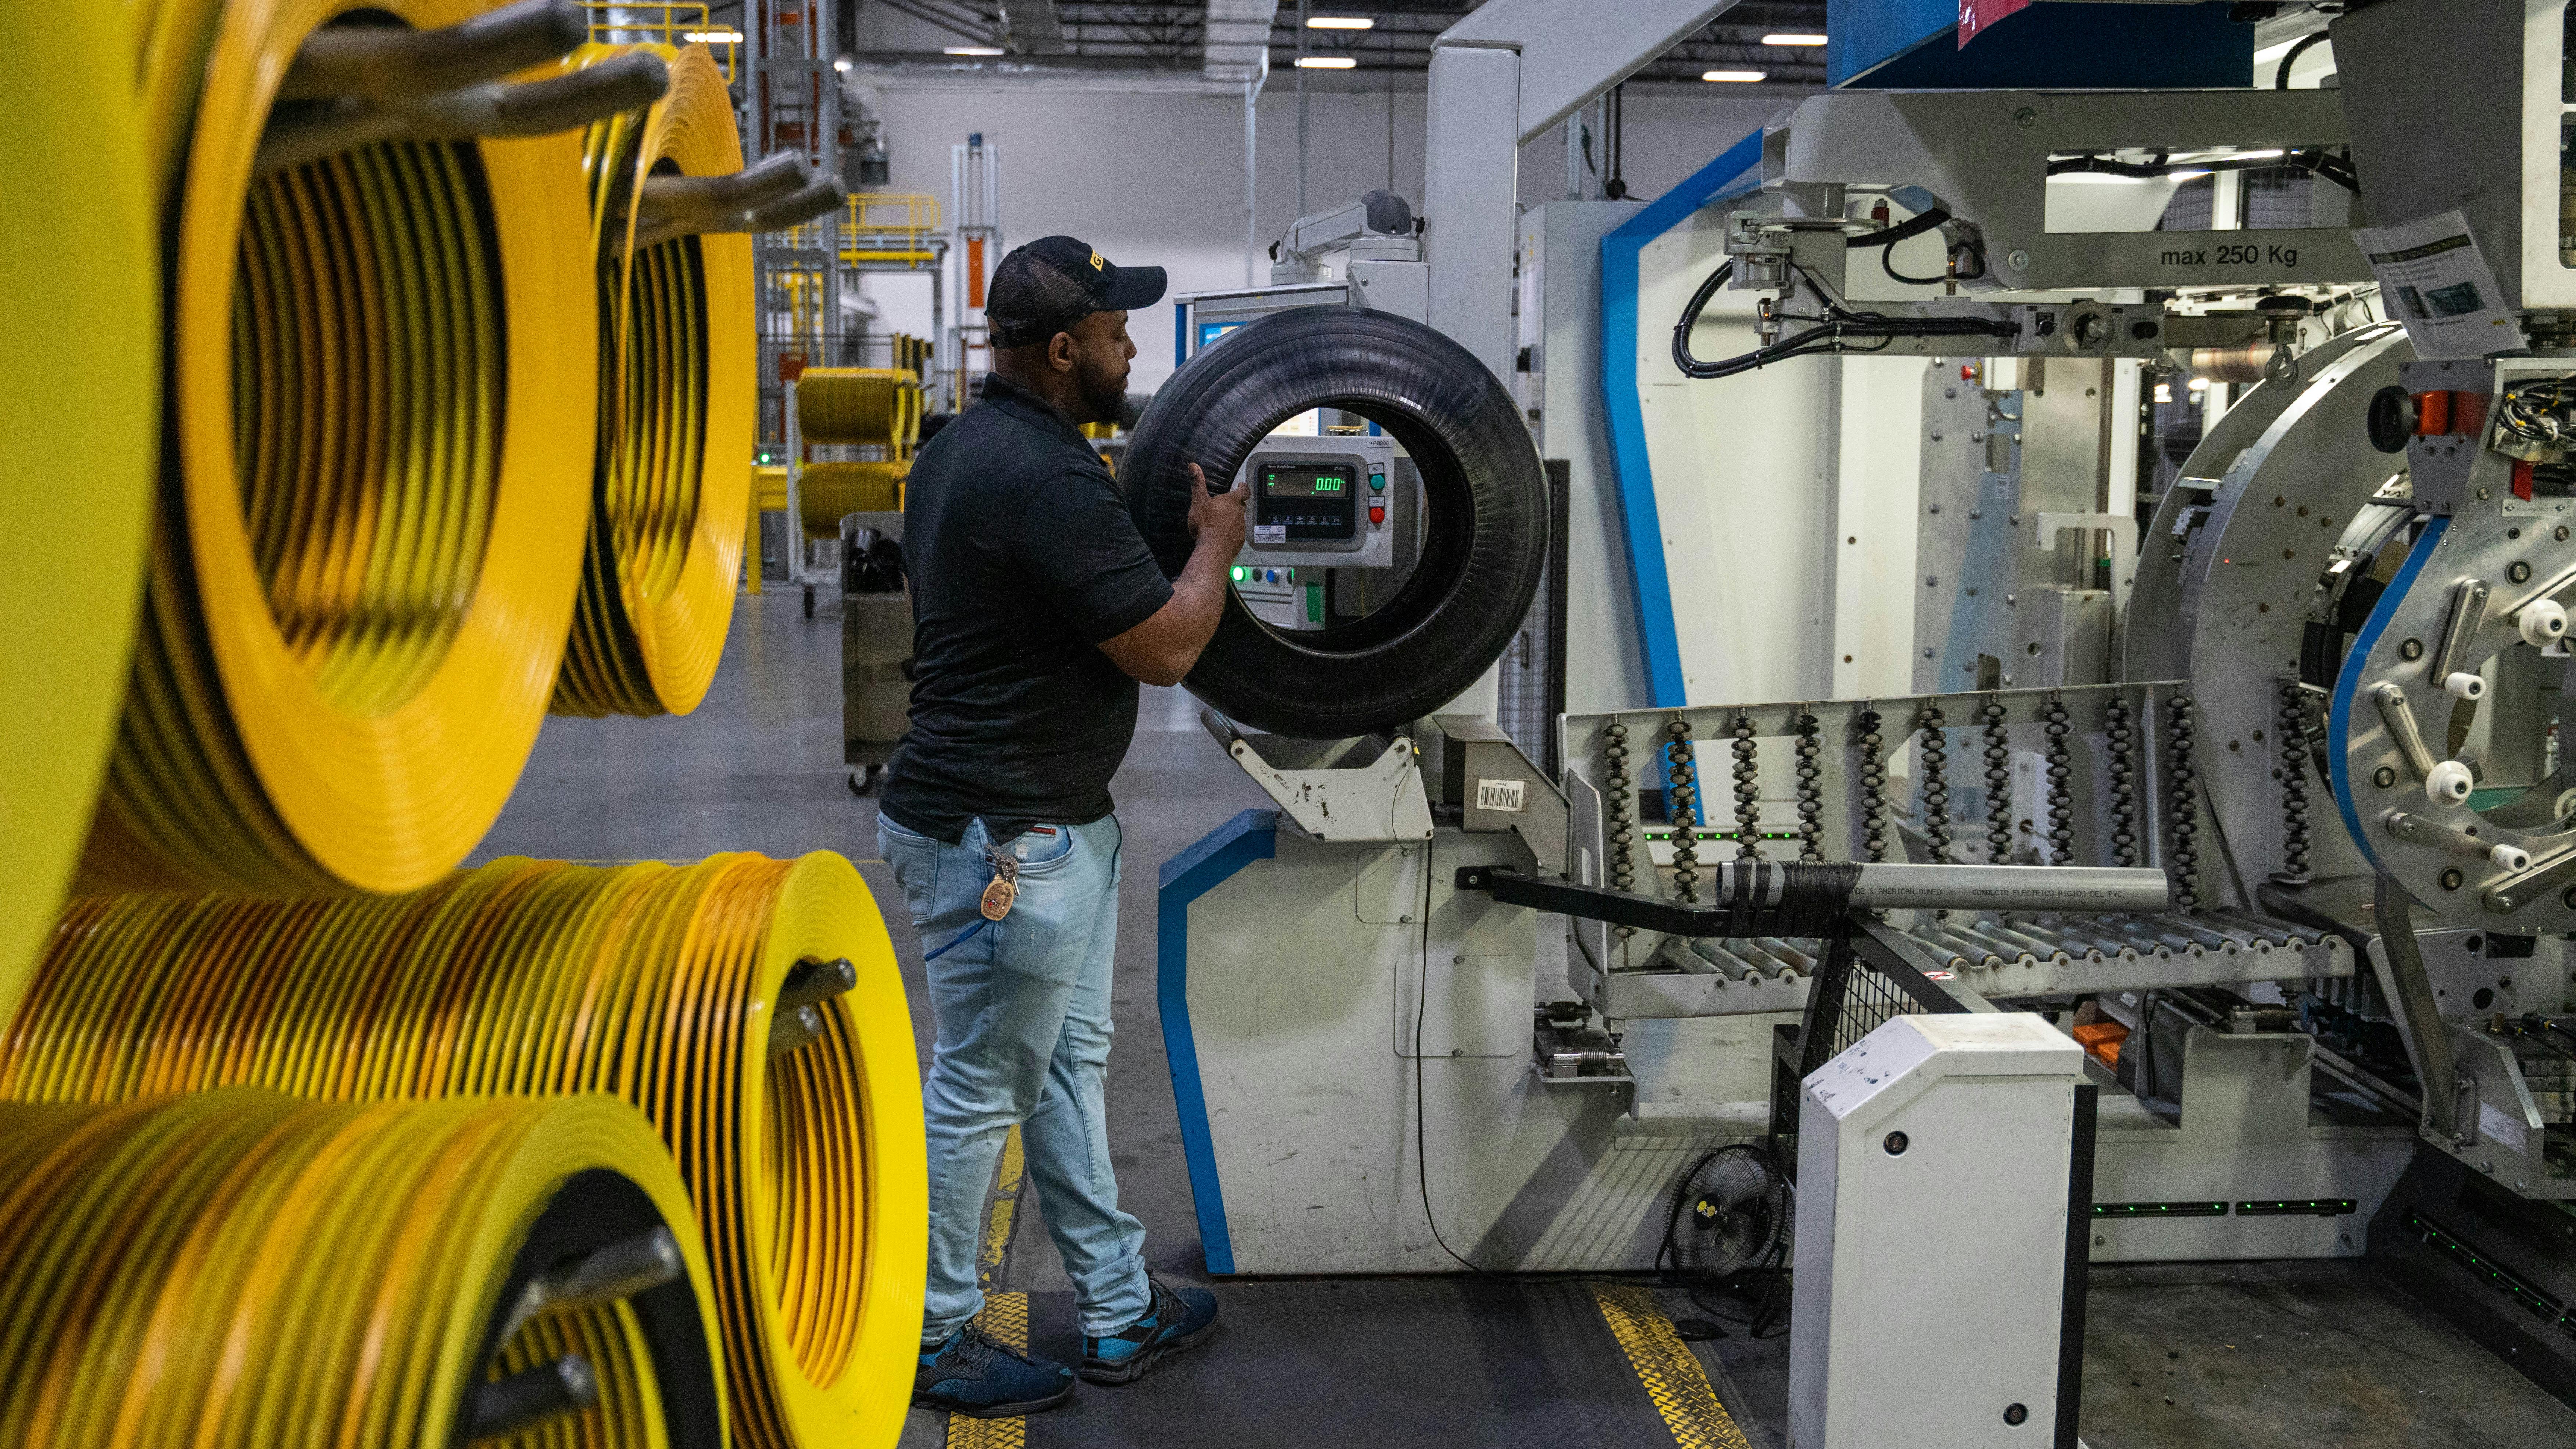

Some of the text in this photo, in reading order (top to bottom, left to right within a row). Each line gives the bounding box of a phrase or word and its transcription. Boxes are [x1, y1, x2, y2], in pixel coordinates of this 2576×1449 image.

[2161, 245, 2297, 268] max 250 Kg
[1316, 477, 1341, 491] 0.00
